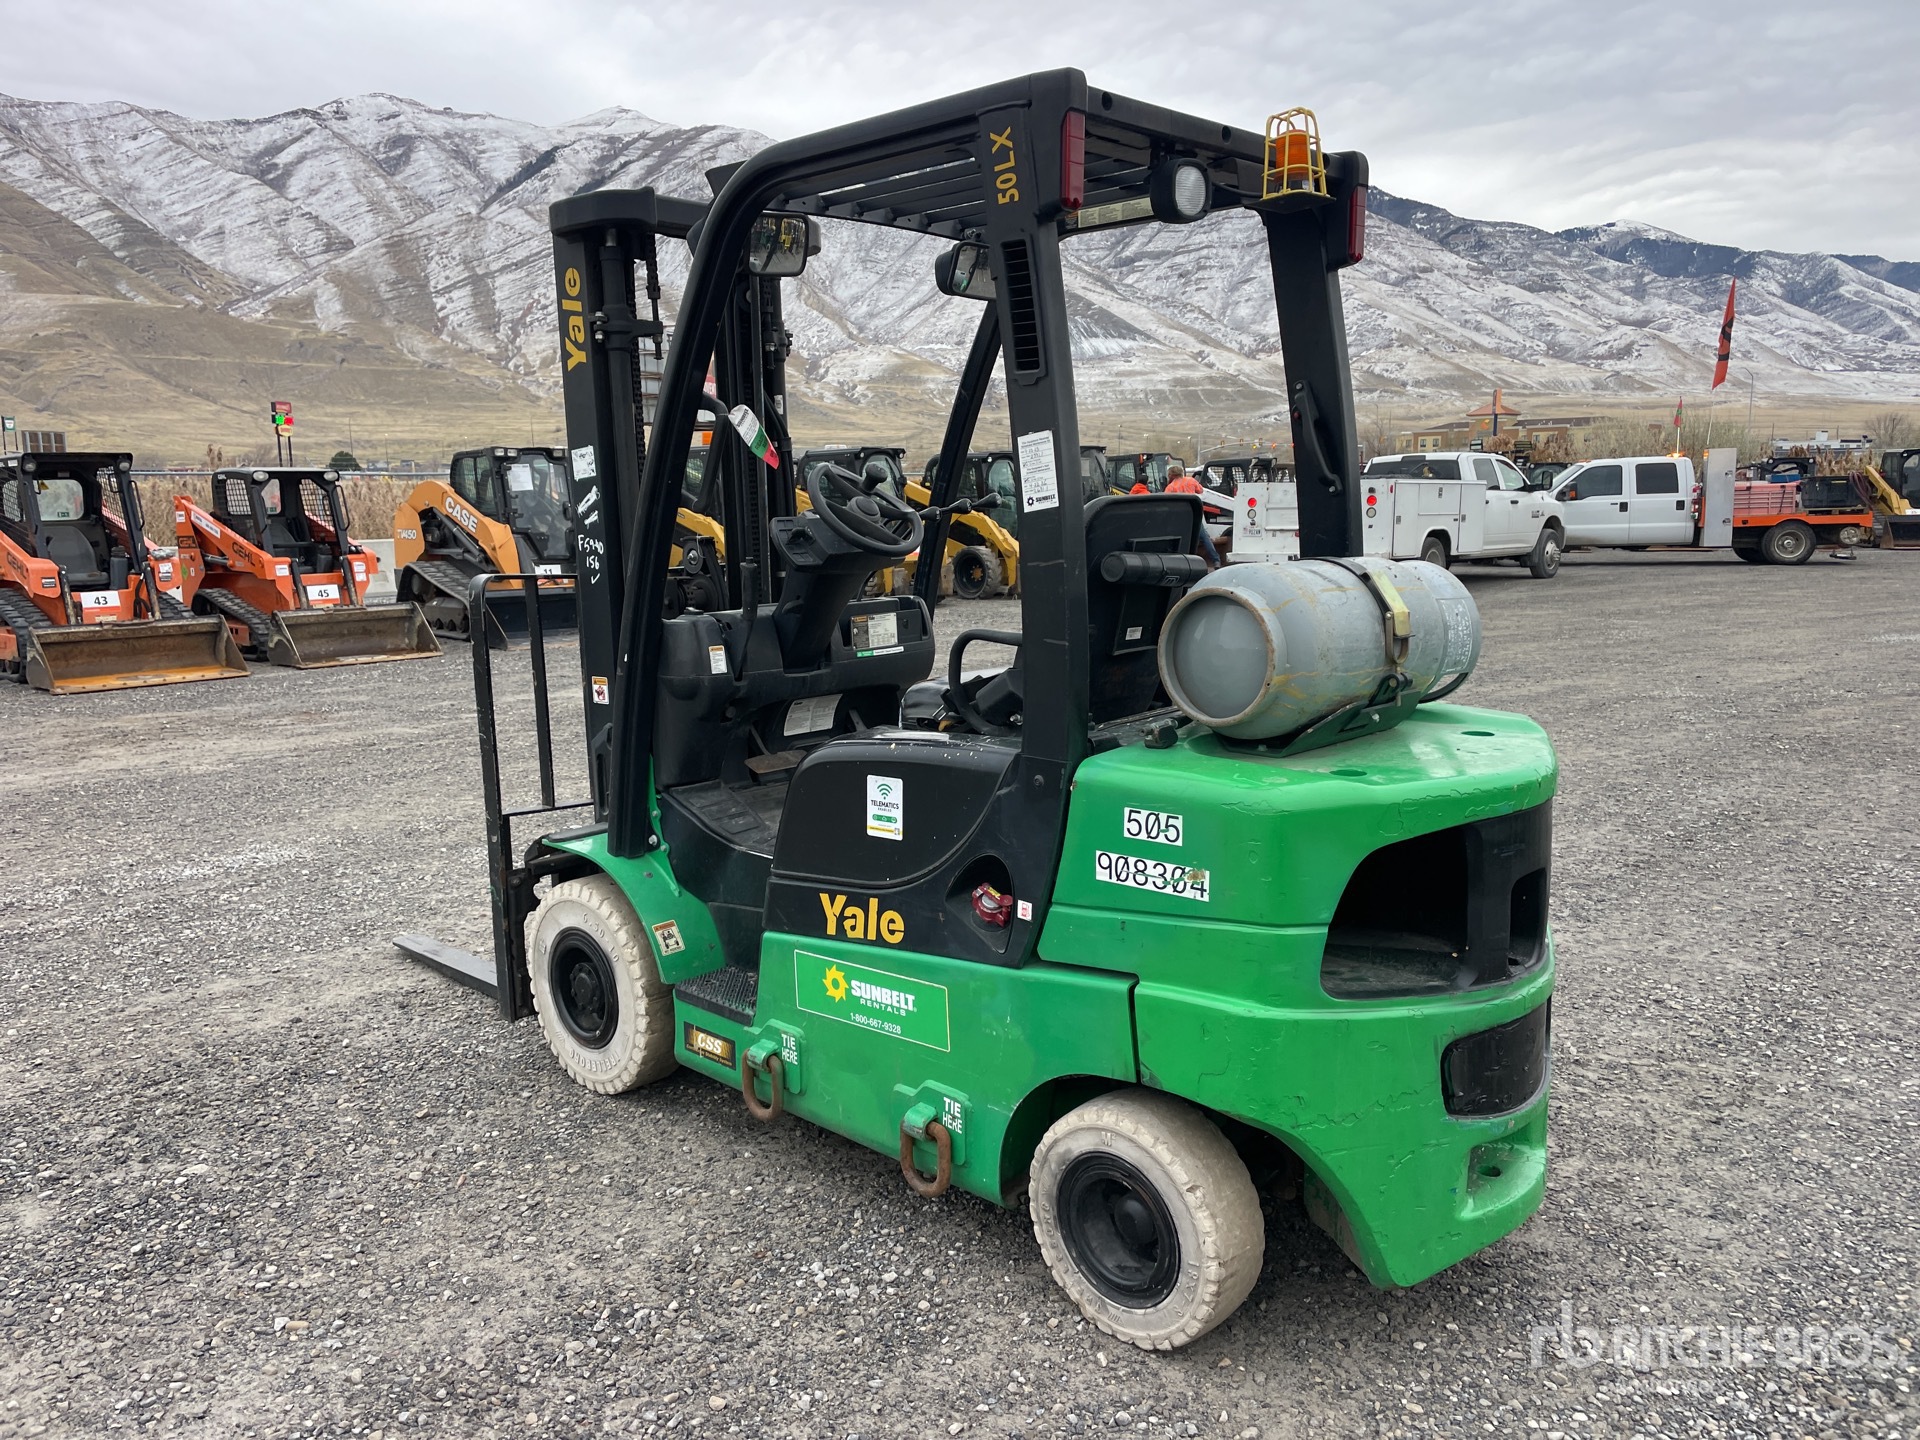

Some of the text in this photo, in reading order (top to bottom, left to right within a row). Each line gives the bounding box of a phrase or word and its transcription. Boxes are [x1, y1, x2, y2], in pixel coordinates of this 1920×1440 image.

[990, 126, 1019, 205] 50LX
[562, 267, 587, 372] Yale
[445, 497, 478, 533] CASE
[232, 541, 256, 567] GEHL
[6, 552, 28, 580] GEHL
[94, 596, 108, 606] 43
[317, 589, 330, 599] 45
[871, 799, 899, 810] TELEMATICS
[1126, 809, 1180, 843] 505
[1097, 852, 1207, 898] 908304
[819, 892, 905, 944] Yale
[850, 979, 916, 1012] SUNBELT
[859, 998, 907, 1017] RENTALS
[850, 1012, 902, 1034] 1-800-667-9328
[697, 1033, 722, 1054] CSS
[781, 1033, 796, 1051] TIE
[781, 1046, 799, 1065] HERE
[943, 1096, 961, 1118] TIE
[942, 1111, 963, 1134] HERE
